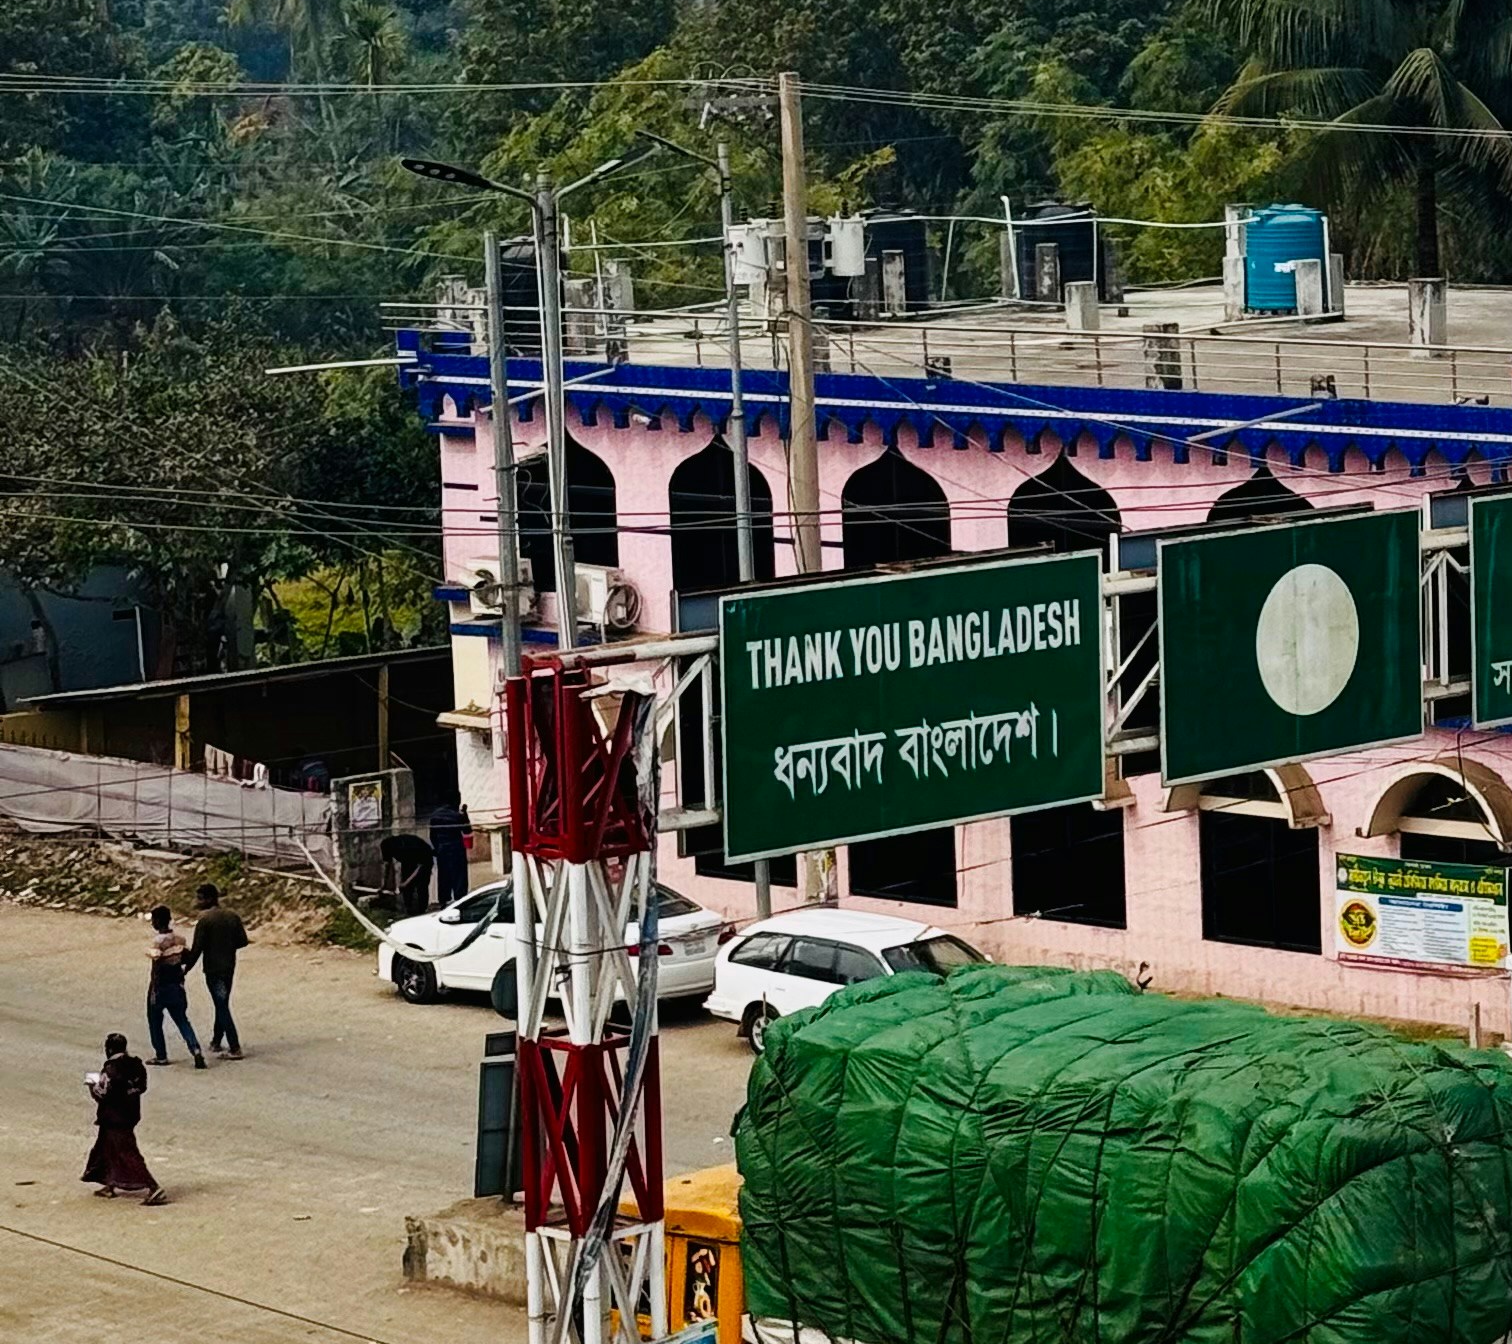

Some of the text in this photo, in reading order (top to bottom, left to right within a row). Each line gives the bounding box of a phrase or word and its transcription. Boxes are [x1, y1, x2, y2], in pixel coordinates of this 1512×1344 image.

[746, 597, 1082, 690] THANK YOU BANGLADESH
[772, 727, 886, 799] ধন্যবাদ
